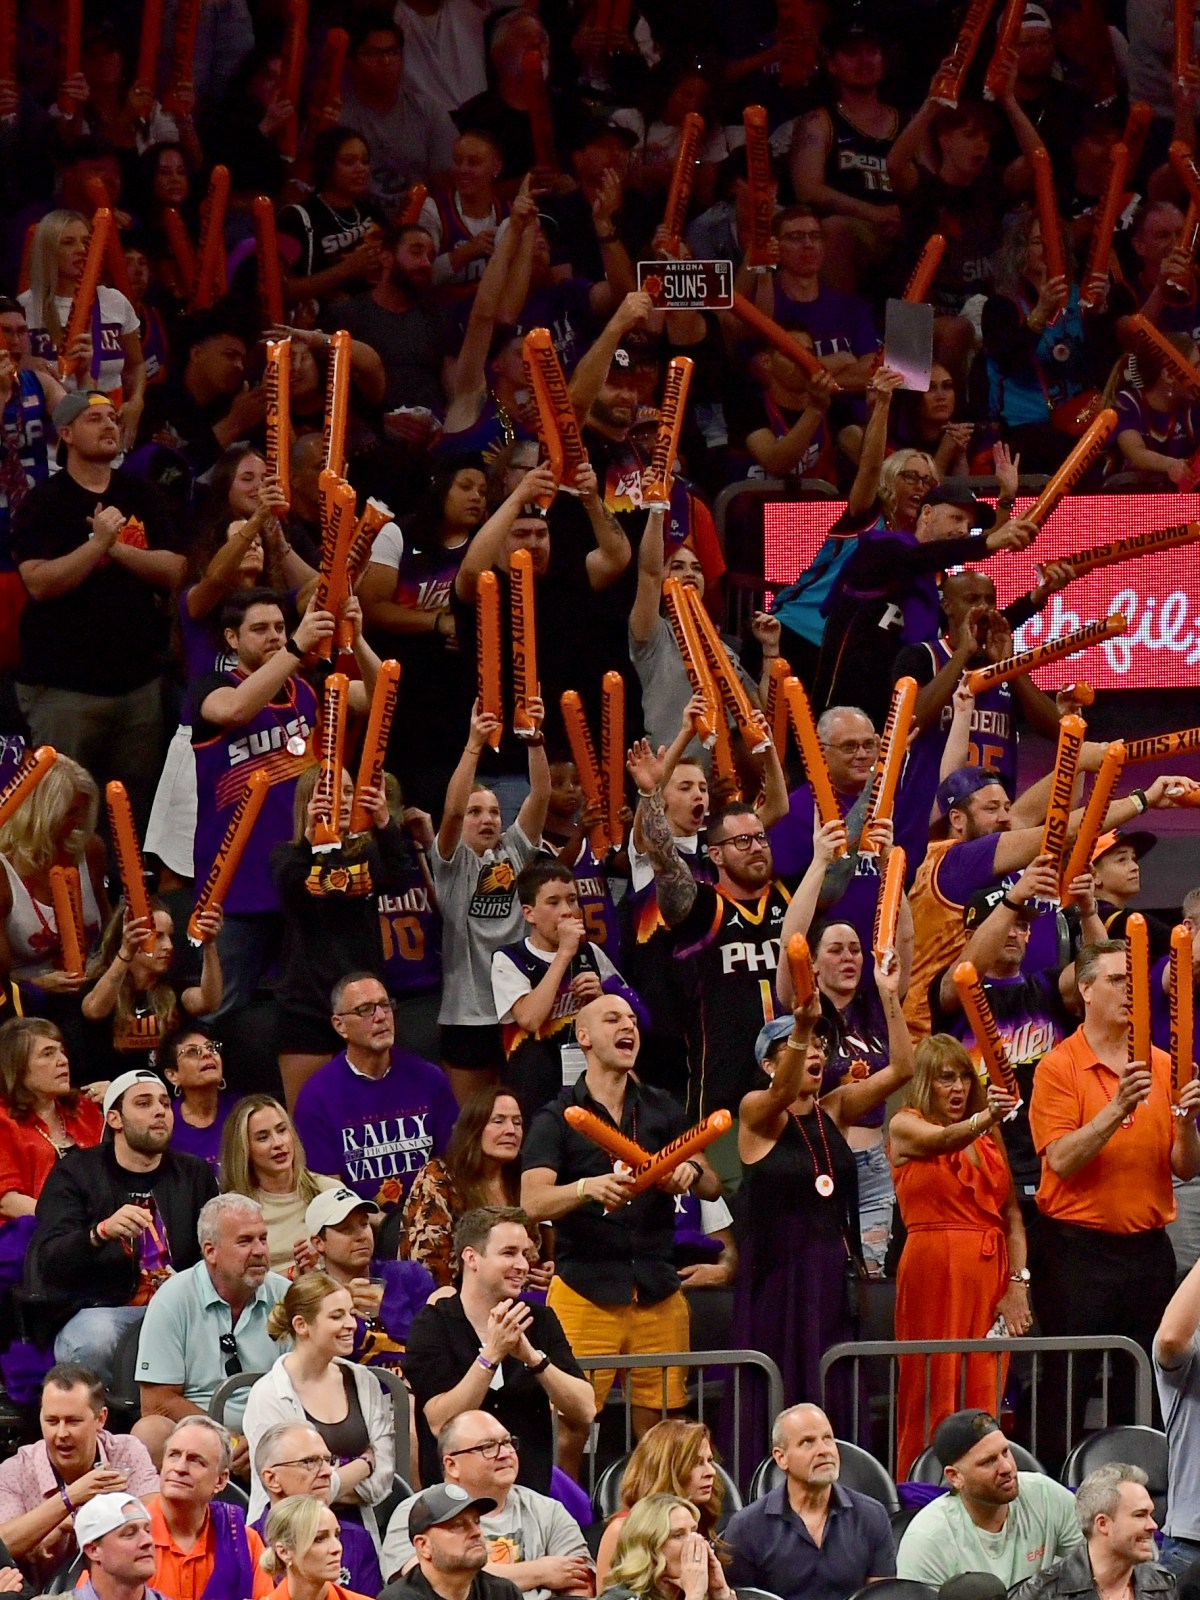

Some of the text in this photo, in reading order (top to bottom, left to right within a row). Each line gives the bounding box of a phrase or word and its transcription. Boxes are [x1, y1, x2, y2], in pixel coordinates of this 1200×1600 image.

[749, 123, 773, 247] PHOENIX SUNS
[664, 274, 729, 299] SUN5 1
[665, 263, 704, 272] ARIZONA
[539, 347, 573, 422] PHOENIX
[651, 366, 685, 483] PHOENIX SUNS
[1117, 523, 1190, 552] PHOENIX
[512, 568, 526, 647] PHOENIX
[983, 621, 1107, 679] PHOENIX SUNS
[228, 716, 310, 765] SUNS
[376, 678, 400, 757] PHOENIX
[1052, 732, 1080, 812] PHOENIX
[220, 785, 252, 864] PHOENIX
[379, 887, 433, 914] ENIX
[469, 902, 511, 917] SUNS
[341, 1113, 431, 1153] RALLY
[366, 1143, 406, 1159] PHOENIX
[408, 1137, 433, 1151] SUNS
[346, 1148, 432, 1183] VALLEY
